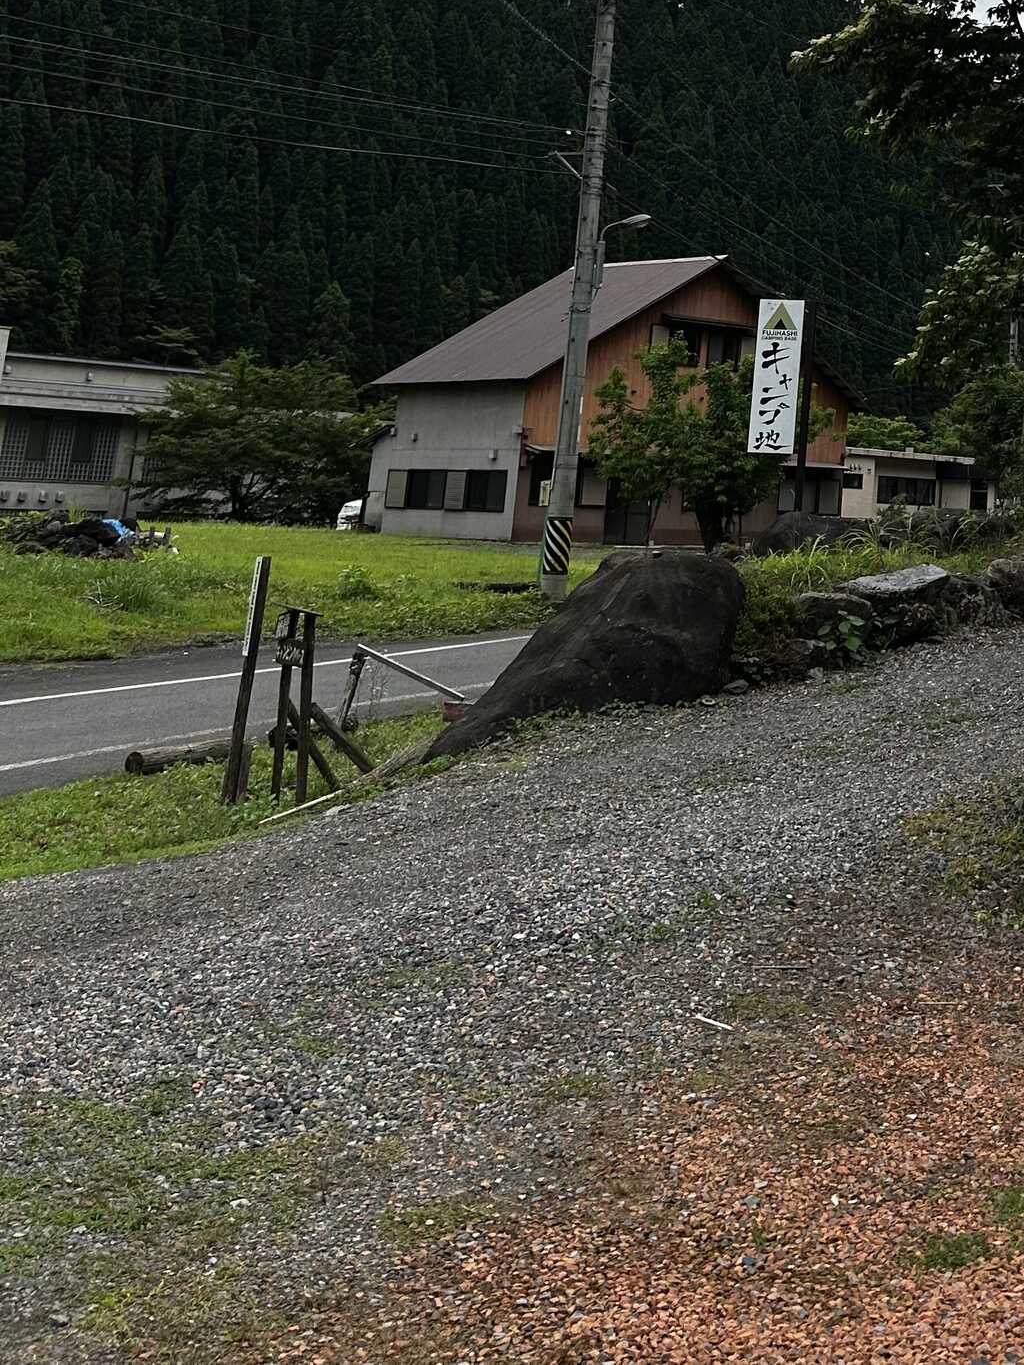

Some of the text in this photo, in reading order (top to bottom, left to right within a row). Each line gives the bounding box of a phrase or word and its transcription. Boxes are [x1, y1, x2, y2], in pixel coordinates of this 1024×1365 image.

[753, 342, 792, 450] キャンプ地
